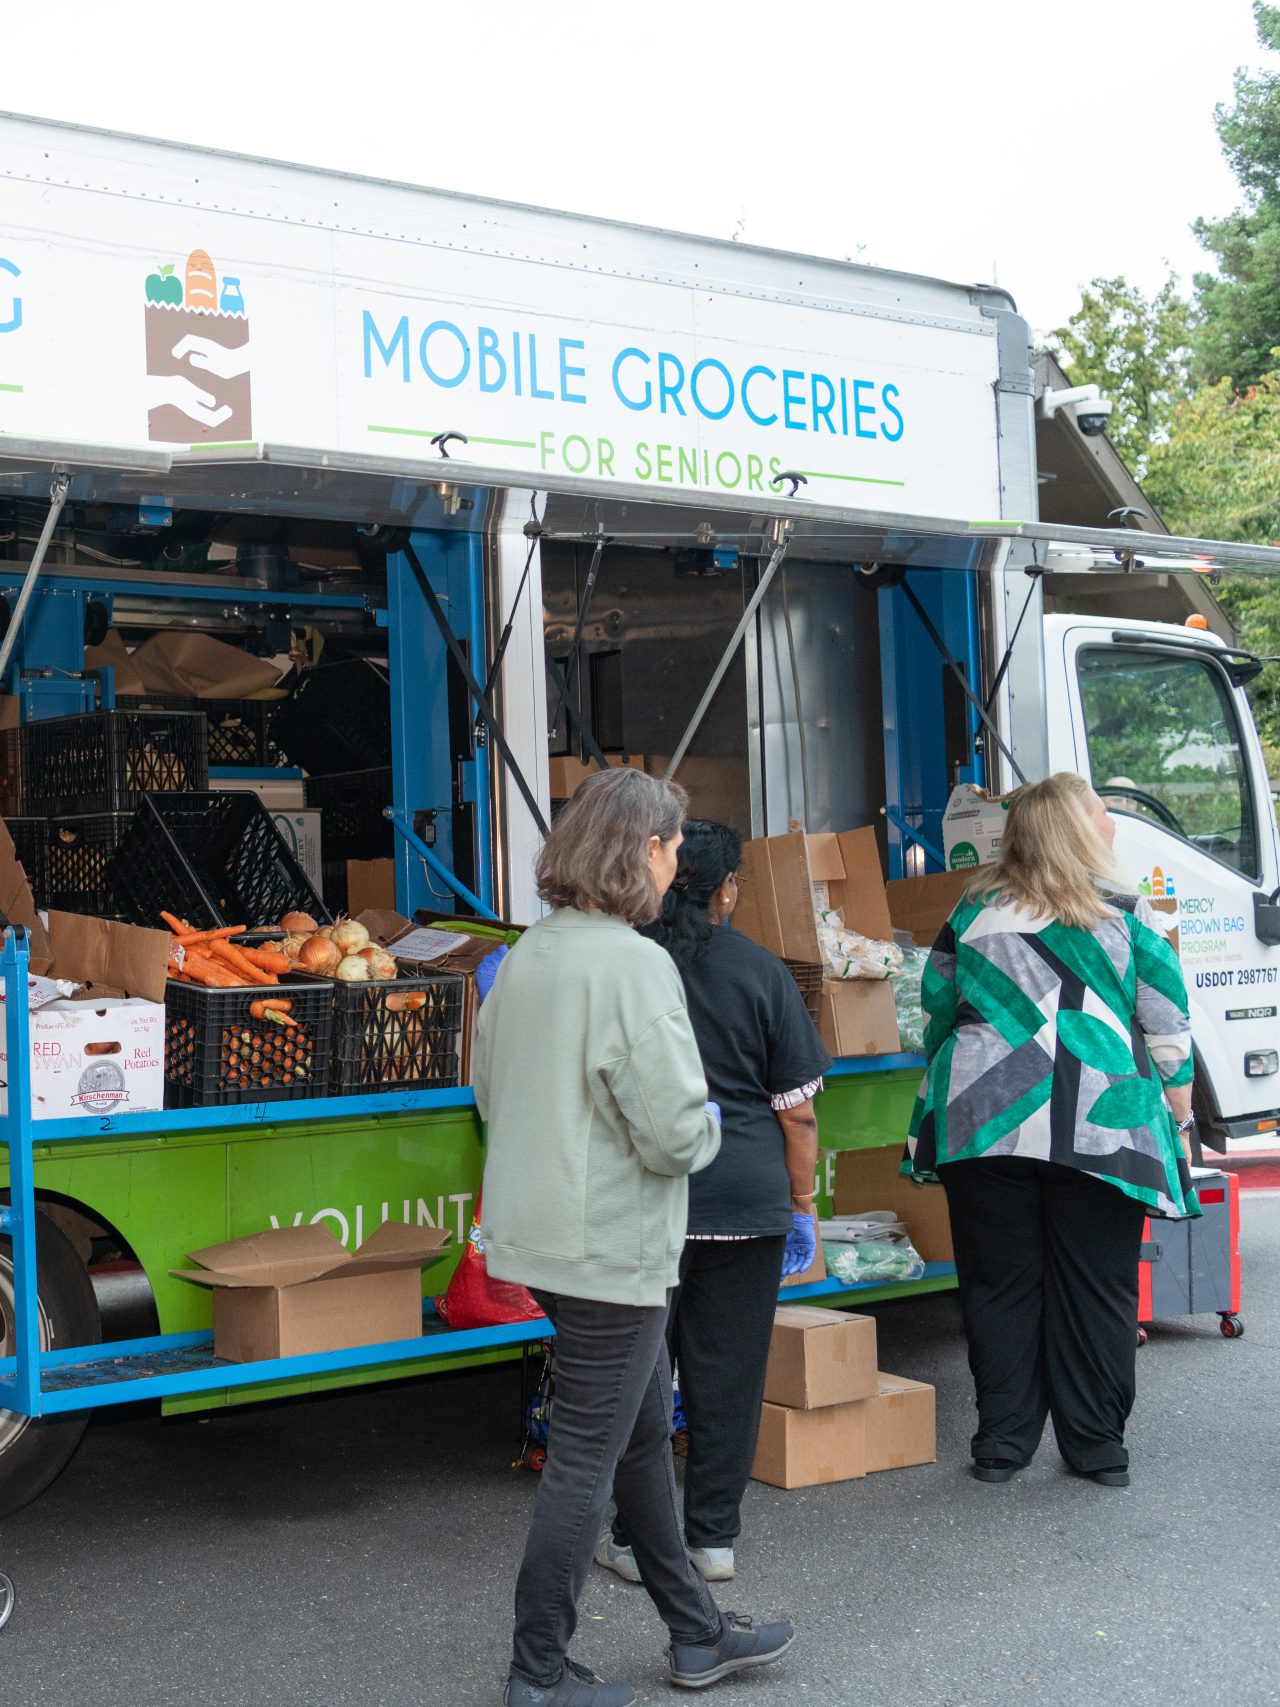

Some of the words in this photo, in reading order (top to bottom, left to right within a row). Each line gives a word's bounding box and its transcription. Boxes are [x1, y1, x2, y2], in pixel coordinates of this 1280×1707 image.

[363, 310, 588, 404] MOBILE
[611, 347, 905, 442] GROCERIES
[541, 432, 615, 477] FOR
[636, 442, 783, 494] SENIORS
[1180, 898, 1215, 914] MERCY
[1180, 918, 1220, 935] BROWN
[1224, 917, 1245, 933] BAG
[1182, 940, 1227, 954] PROGRAM
[1196, 971, 1234, 988] USDOT
[1237, 968, 1278, 985] 2987767
[33, 1042, 62, 1056] RED
[134, 1047, 151, 1059] Red
[34, 1053, 82, 1072] SWAN
[124, 1058, 160, 1070] Potatoes
[78, 1091, 123, 1102] Kirschenman
[99, 1117, 113, 1131] 2
